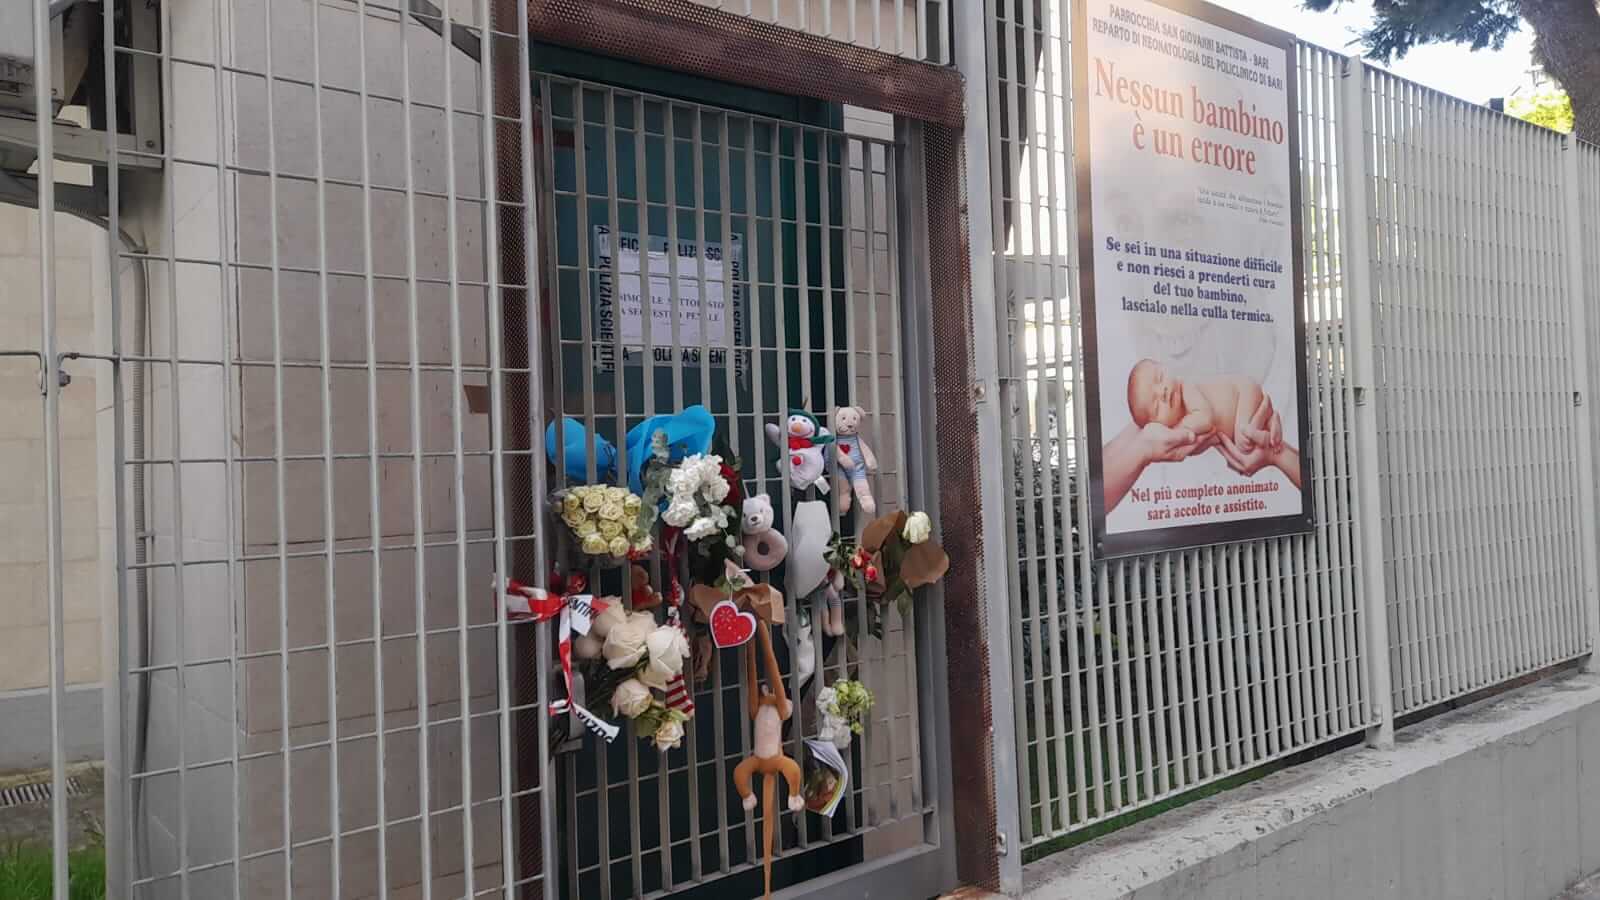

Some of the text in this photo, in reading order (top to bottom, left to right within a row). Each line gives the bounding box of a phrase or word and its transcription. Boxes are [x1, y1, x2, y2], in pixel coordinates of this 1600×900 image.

[1110, 4, 1160, 33] PARROCCHIA
[1162, 23, 1178, 39] SAN
[1180, 29, 1214, 51] GIOVANNI
[1216, 41, 1247, 62] BATTISTA
[1253, 54, 1269, 70] BARI
[1092, 17, 1283, 90] REPARTO DI NEONATOLOGIA DEL POLICLINICO DI BARI
[1094, 57, 1284, 145] Nessun bambino
[1132, 110, 1257, 175] è un errore
[1106, 236, 1283, 273] Se sei in una situazione difficile
[1117, 261, 1276, 289] e non riesci a prenderti cura
[1153, 281, 1247, 304] del tuo bambino,
[1122, 296, 1274, 323] lascialo nella culla termica.
[1131, 480, 1279, 504] Nel più completo anonimato
[1147, 498, 1268, 520] sarà accolto e assistito.
